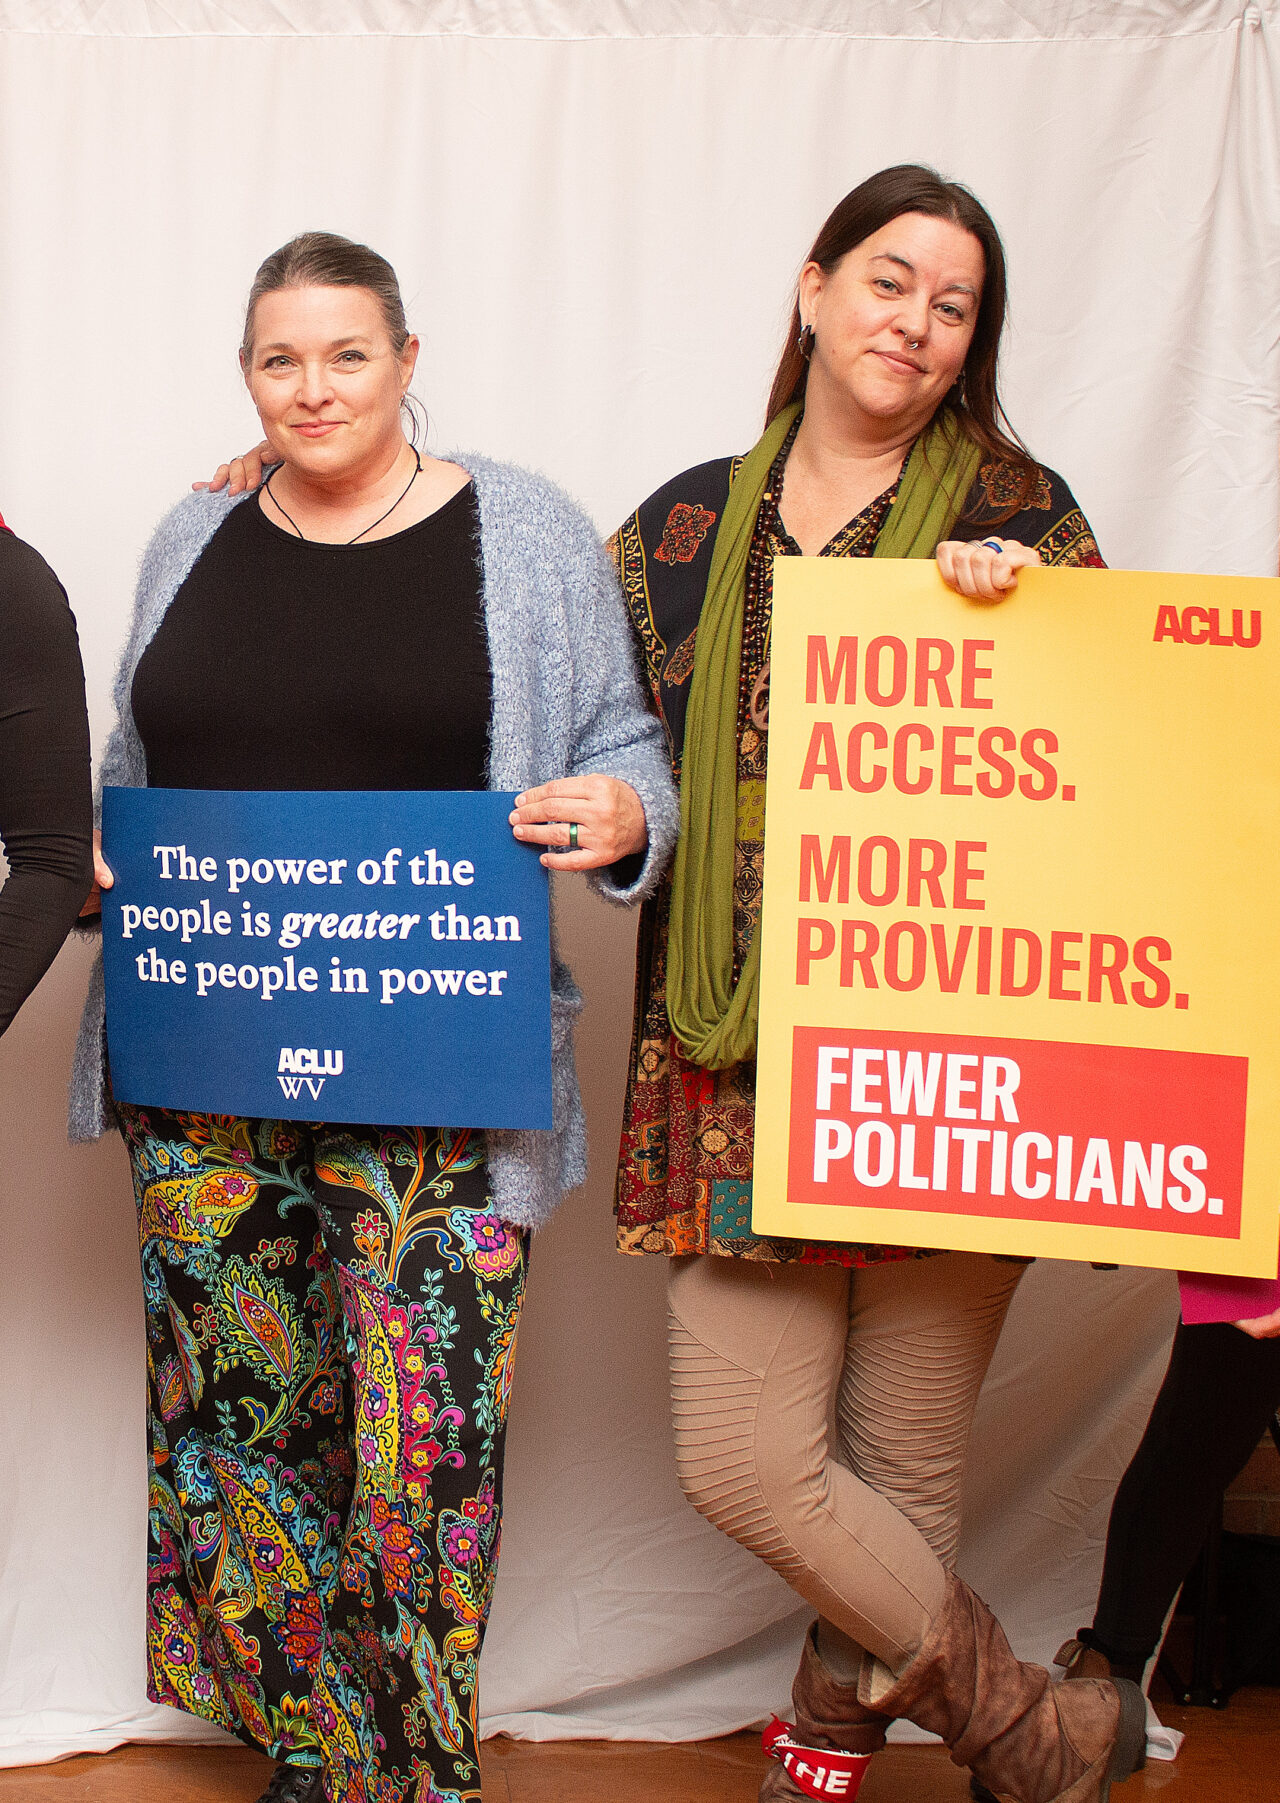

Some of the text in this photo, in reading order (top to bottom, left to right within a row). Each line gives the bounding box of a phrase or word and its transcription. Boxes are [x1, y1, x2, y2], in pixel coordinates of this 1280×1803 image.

[1153, 605, 1262, 649] ACLU
[805, 634, 995, 710] MORE
[799, 721, 1077, 802] ACCESS.
[153, 844, 475, 893] The power of the
[798, 834, 987, 911] MORE
[121, 899, 522, 948] people is greater than
[135, 948, 508, 1004] the people in power
[794, 917, 1190, 1011] PROVIDERS.
[277, 1047, 344, 1076] ACLU
[277, 1075, 326, 1101] WV
[817, 1045, 1022, 1123] FEWER
[813, 1118, 1225, 1215] POLITICIANS.
